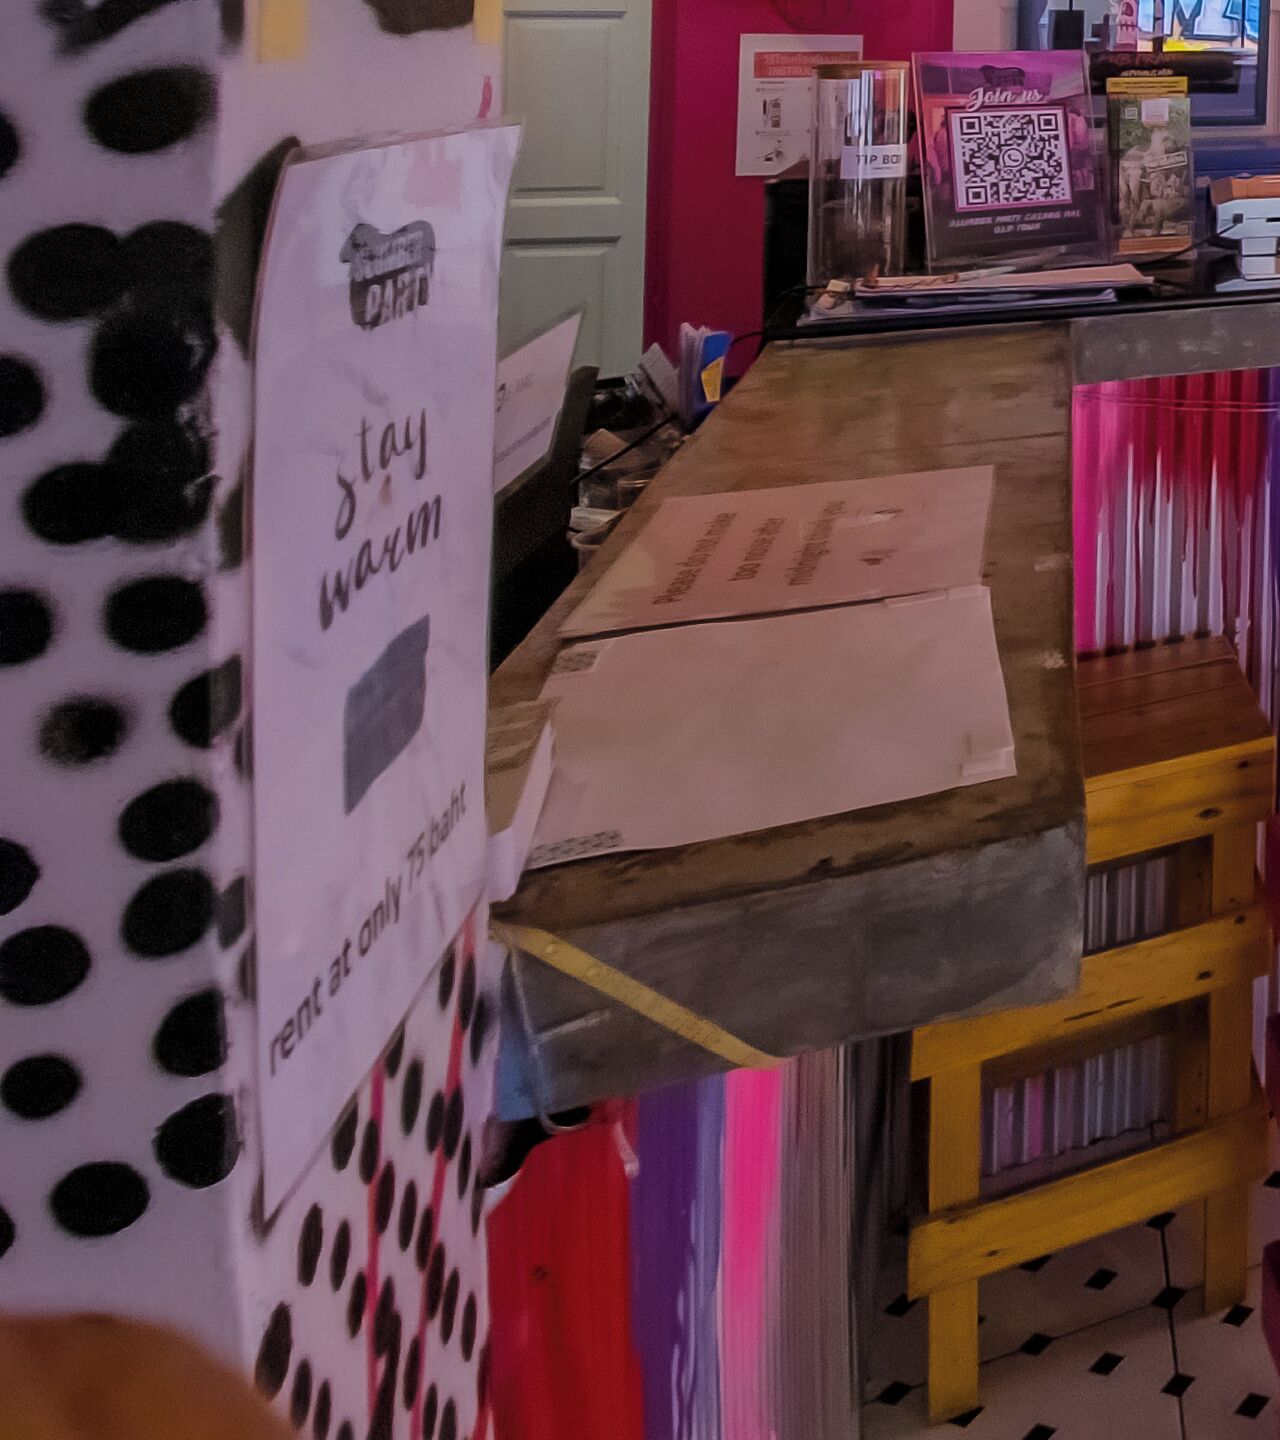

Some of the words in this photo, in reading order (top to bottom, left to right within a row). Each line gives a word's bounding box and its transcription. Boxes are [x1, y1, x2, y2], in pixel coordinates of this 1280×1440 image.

[856, 154, 878, 165] TIP
[965, 87, 1016, 112] Join
[1020, 90, 1043, 102] us
[336, 406, 427, 542] stay
[319, 493, 443, 632] warm
[269, 976, 322, 1078] rent
[329, 937, 352, 998] at
[358, 873, 403, 959] only
[429, 781, 467, 862] baht
